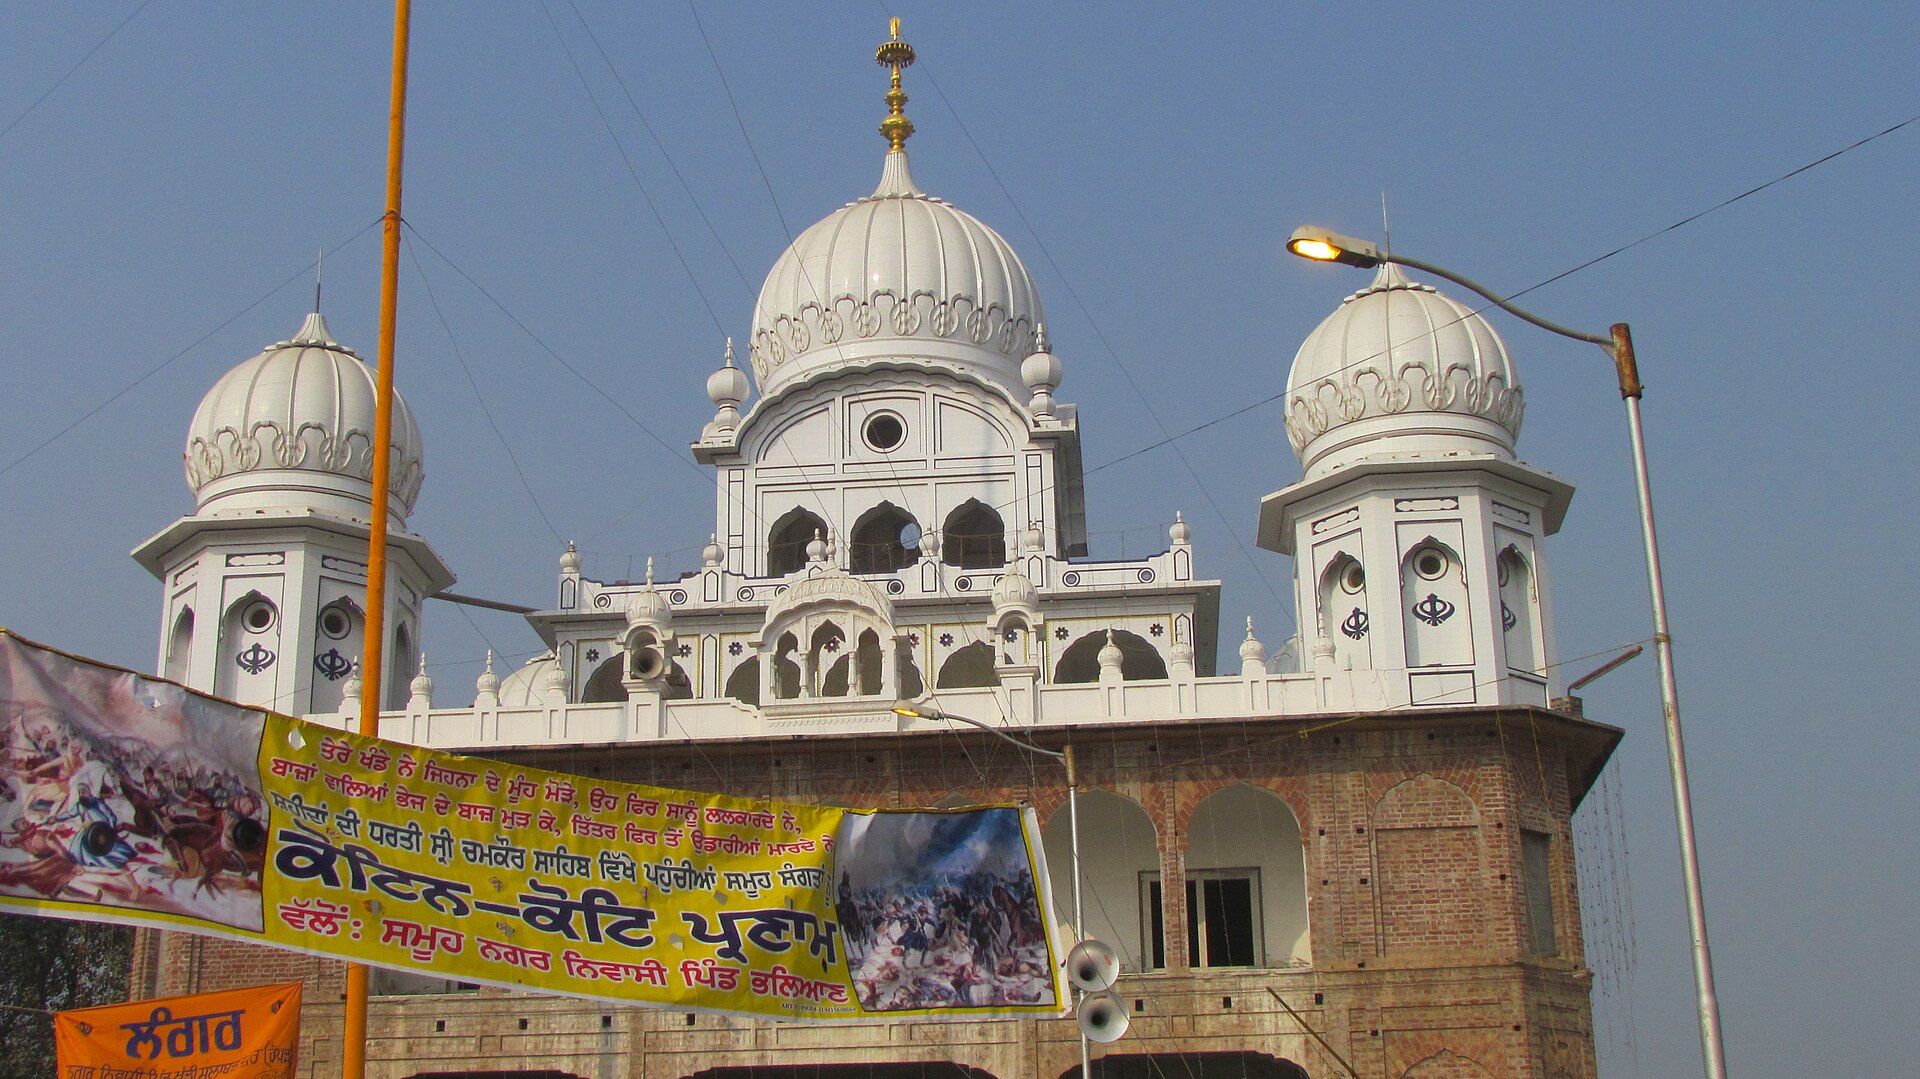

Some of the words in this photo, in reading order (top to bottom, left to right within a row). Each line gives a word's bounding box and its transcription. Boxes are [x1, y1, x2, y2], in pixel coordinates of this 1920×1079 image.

[271, 758, 318, 782] ਬਾਜ਼ਾਂ
[324, 774, 389, 802] ਵਾਲਿਆਂ
[395, 785, 427, 811] ਭੇਜ
[434, 792, 451, 816] ਦੇ
[457, 802, 496, 822] ਬਾਜ਼
[501, 810, 532, 830] ਮੁੜ
[537, 809, 562, 837] ਕੇ,
[571, 814, 618, 841] ਤਿੱਤਰ
[624, 822, 658, 846] ਫਿਰ
[663, 826, 684, 847] ਤੋਂ
[691, 829, 761, 856] ਉਡਾਰੀਆਂ
[766, 839, 816, 856] ਮਾਰਦੇ
[320, 736, 353, 764] ਤੇਰੇ
[359, 747, 391, 771] ਖੰਡੇ
[397, 753, 417, 777] ਨੇ
[423, 759, 478, 789] ਜਿਹਨਾ
[485, 769, 501, 792] ਦੇ
[507, 775, 538, 803] ਮੂੰਹ
[544, 778, 580, 810] ਮੋੜੇ,
[589, 788, 620, 813] ਉਹ
[625, 792, 660, 817] ਫਿਰ
[665, 799, 699, 827] ਸਾਨੂੰ
[705, 807, 775, 829] ਲਲਕਾਰਦੇ
[782, 810, 802, 835] ਨੇ,
[335, 808, 361, 838] ਦੀ
[368, 821, 423, 852] ਧਰਤੀ
[429, 828, 454, 865] ਸ੍ਰੀ
[461, 835, 527, 869] ਚਮਕੌਰ
[533, 845, 592, 878] ਸਾਹਿਬ
[598, 850, 637, 883] ਵਿੱਖੇ
[643, 857, 717, 892] ਪਹੁੰਚੀਆਂ
[723, 871, 771, 898] ਸਮੂਹ
[777, 863, 825, 890] ਸੰਗਤਾਂ
[381, 919, 466, 961] ਸਮੂਹ
[476, 936, 551, 972] ਨਗਰ
[562, 949, 668, 986] ਨਿਵਾਸੀ
[680, 959, 741, 990] ਪਿੰਡ
[750, 965, 849, 1003] ਭਲਿਆਣ
[681, 909, 838, 964] ਪ੍ਰਣਾਮ
[120, 1006, 246, 1060] ਲੰਗਰ
